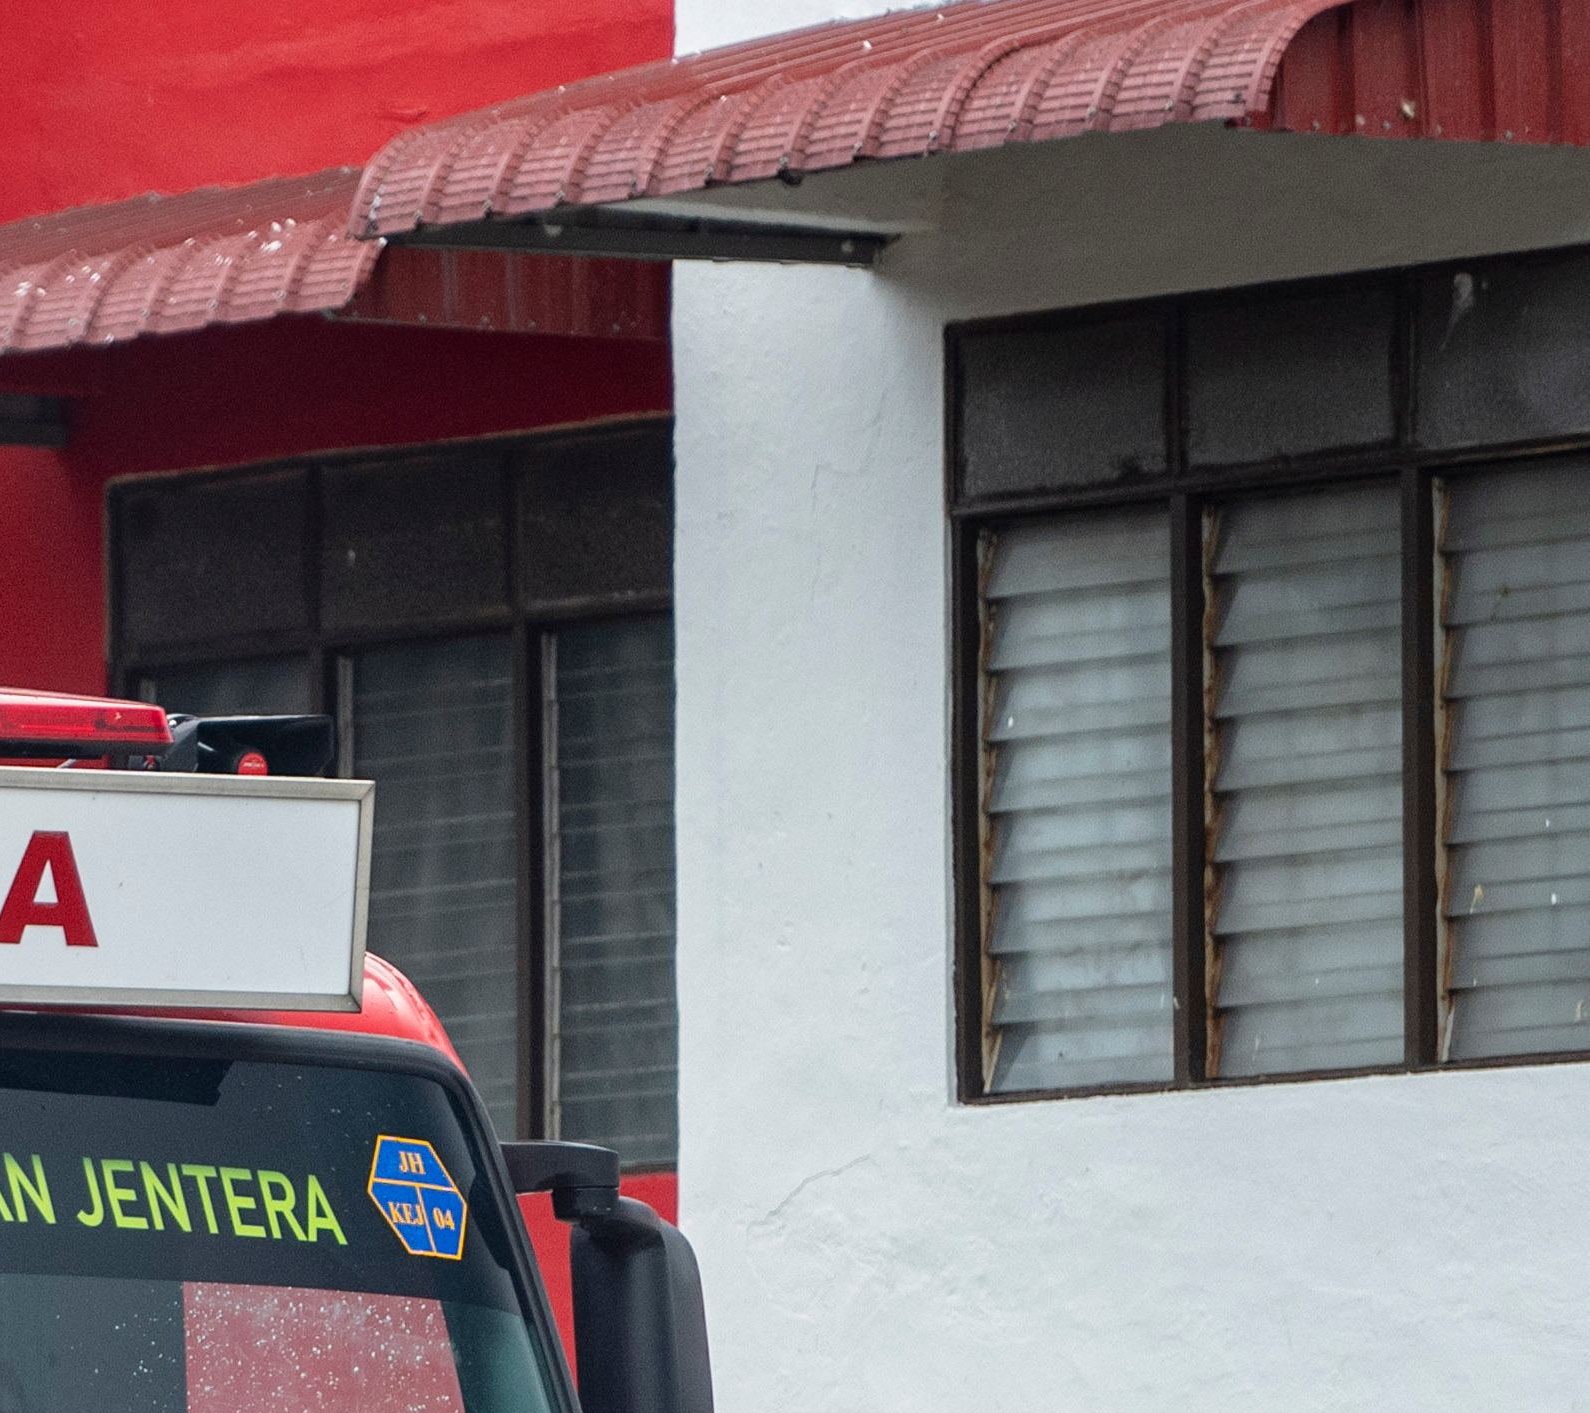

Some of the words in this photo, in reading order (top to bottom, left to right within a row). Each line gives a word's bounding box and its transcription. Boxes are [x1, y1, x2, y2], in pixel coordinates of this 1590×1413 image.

[399, 1151, 426, 1175] JH
[76, 1156, 348, 1246] JENTERA
[387, 1201, 424, 1226] KEJ
[432, 1207, 455, 1231] 04
